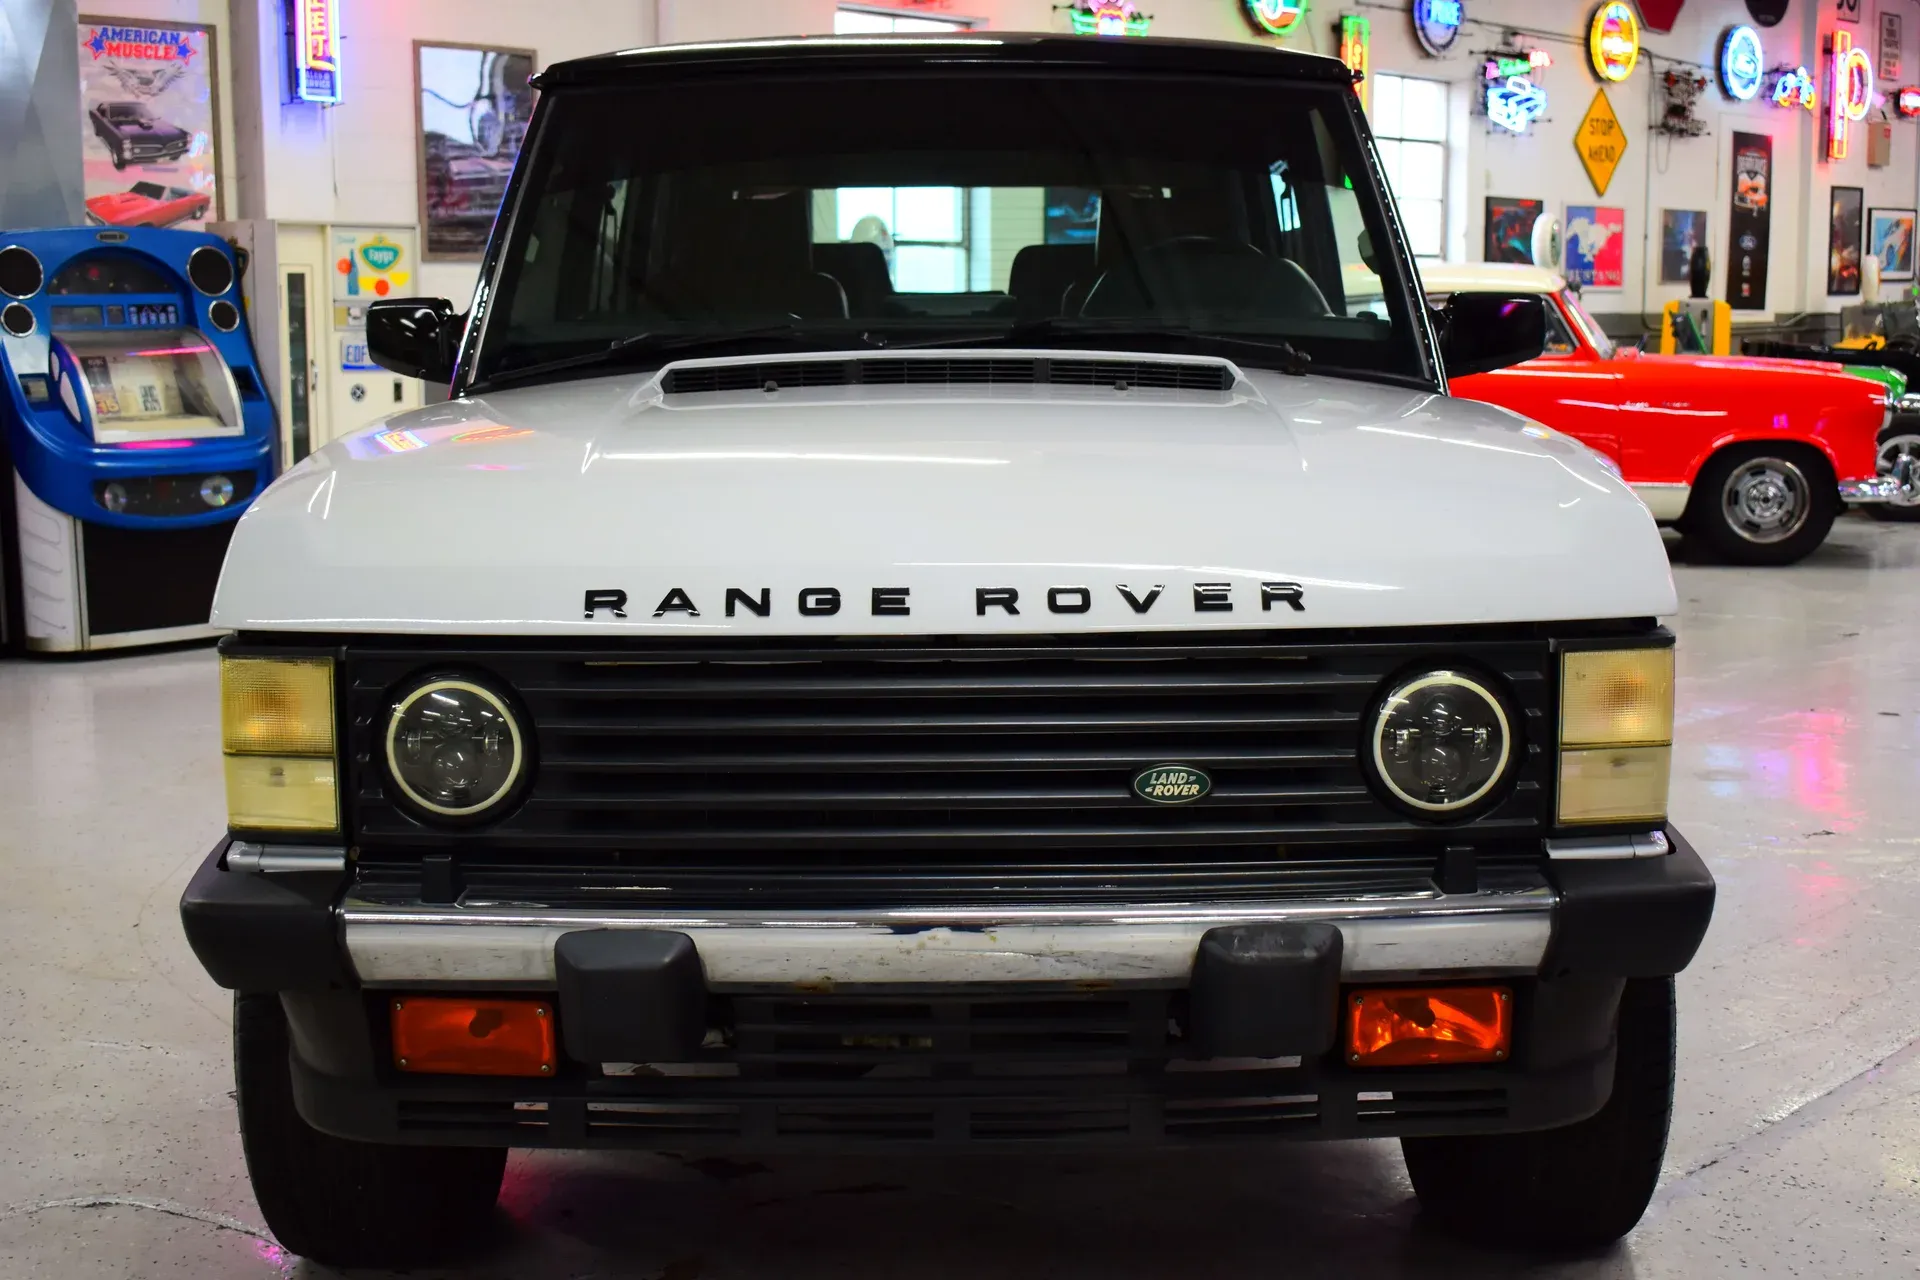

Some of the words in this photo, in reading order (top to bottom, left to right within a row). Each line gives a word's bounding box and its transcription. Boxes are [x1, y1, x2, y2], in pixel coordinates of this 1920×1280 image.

[99, 26, 181, 45] AMERICAN
[1589, 117, 1615, 136] STOP
[1588, 144, 1616, 163] AHEAD
[368, 248, 394, 265] Faygo
[584, 587, 910, 618] RANGE
[976, 582, 1305, 615] ROVER
[1150, 772, 1188, 785] LAND
[1153, 784, 1200, 796] ROVER
